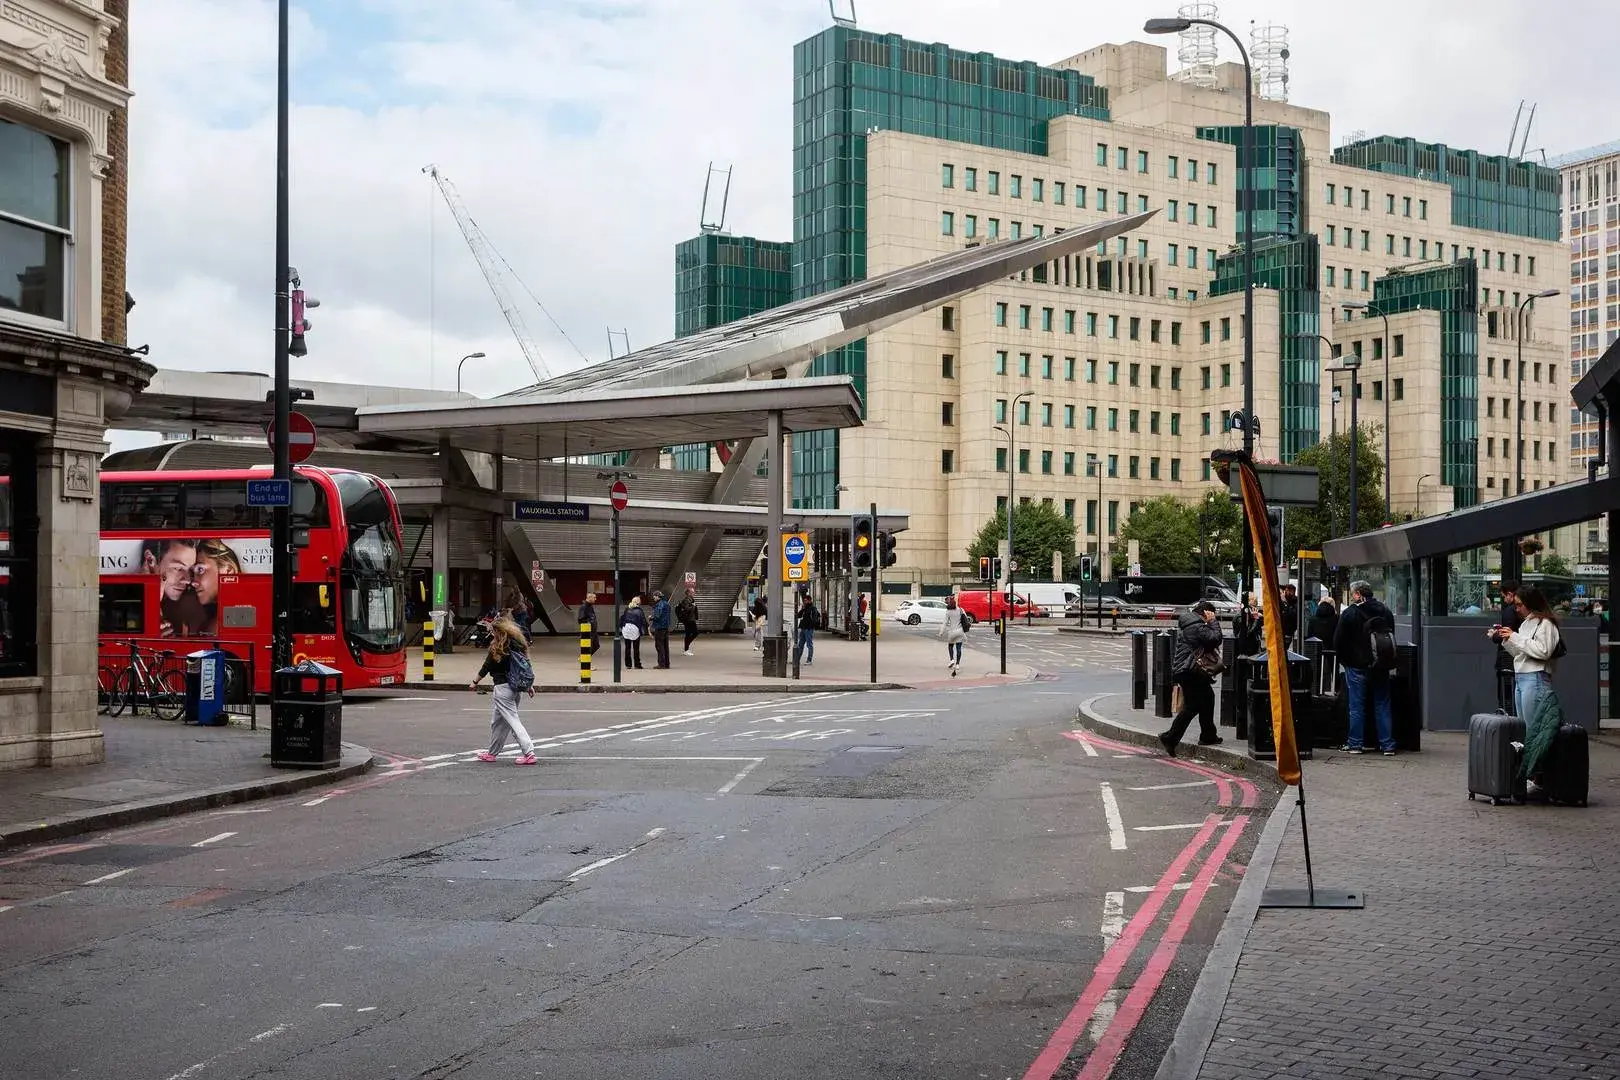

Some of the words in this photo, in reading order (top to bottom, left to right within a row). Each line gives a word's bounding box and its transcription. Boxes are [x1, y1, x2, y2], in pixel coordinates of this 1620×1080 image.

[254, 484, 271, 492] End
[272, 484, 283, 492] of
[250, 493, 266, 502] bus
[267, 493, 286, 502] lane
[520, 506, 556, 515] VAUXHALL
[557, 507, 585, 516] STATION
[790, 569, 801, 577] Only
